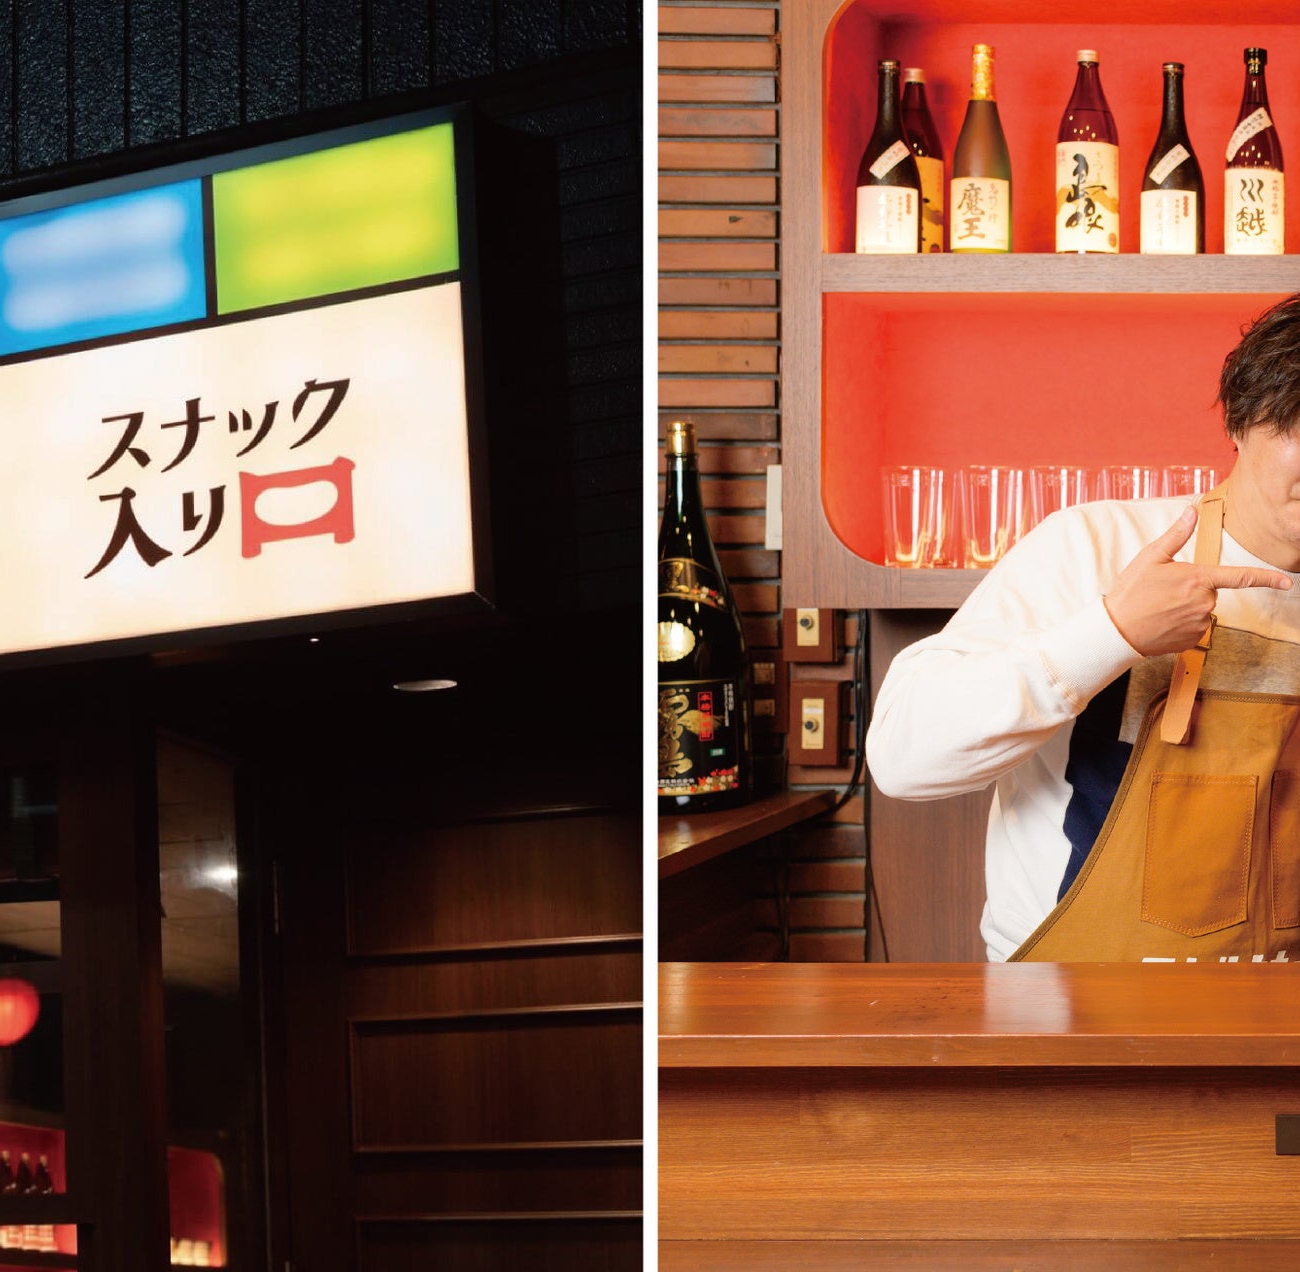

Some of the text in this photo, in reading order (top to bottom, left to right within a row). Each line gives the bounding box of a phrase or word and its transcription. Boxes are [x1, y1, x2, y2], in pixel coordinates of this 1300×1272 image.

[957, 183, 986, 240] 魔王
[1236, 178, 1268, 237] 川越
[86, 377, 351, 481] スナック
[83, 456, 357, 580] 入り口
